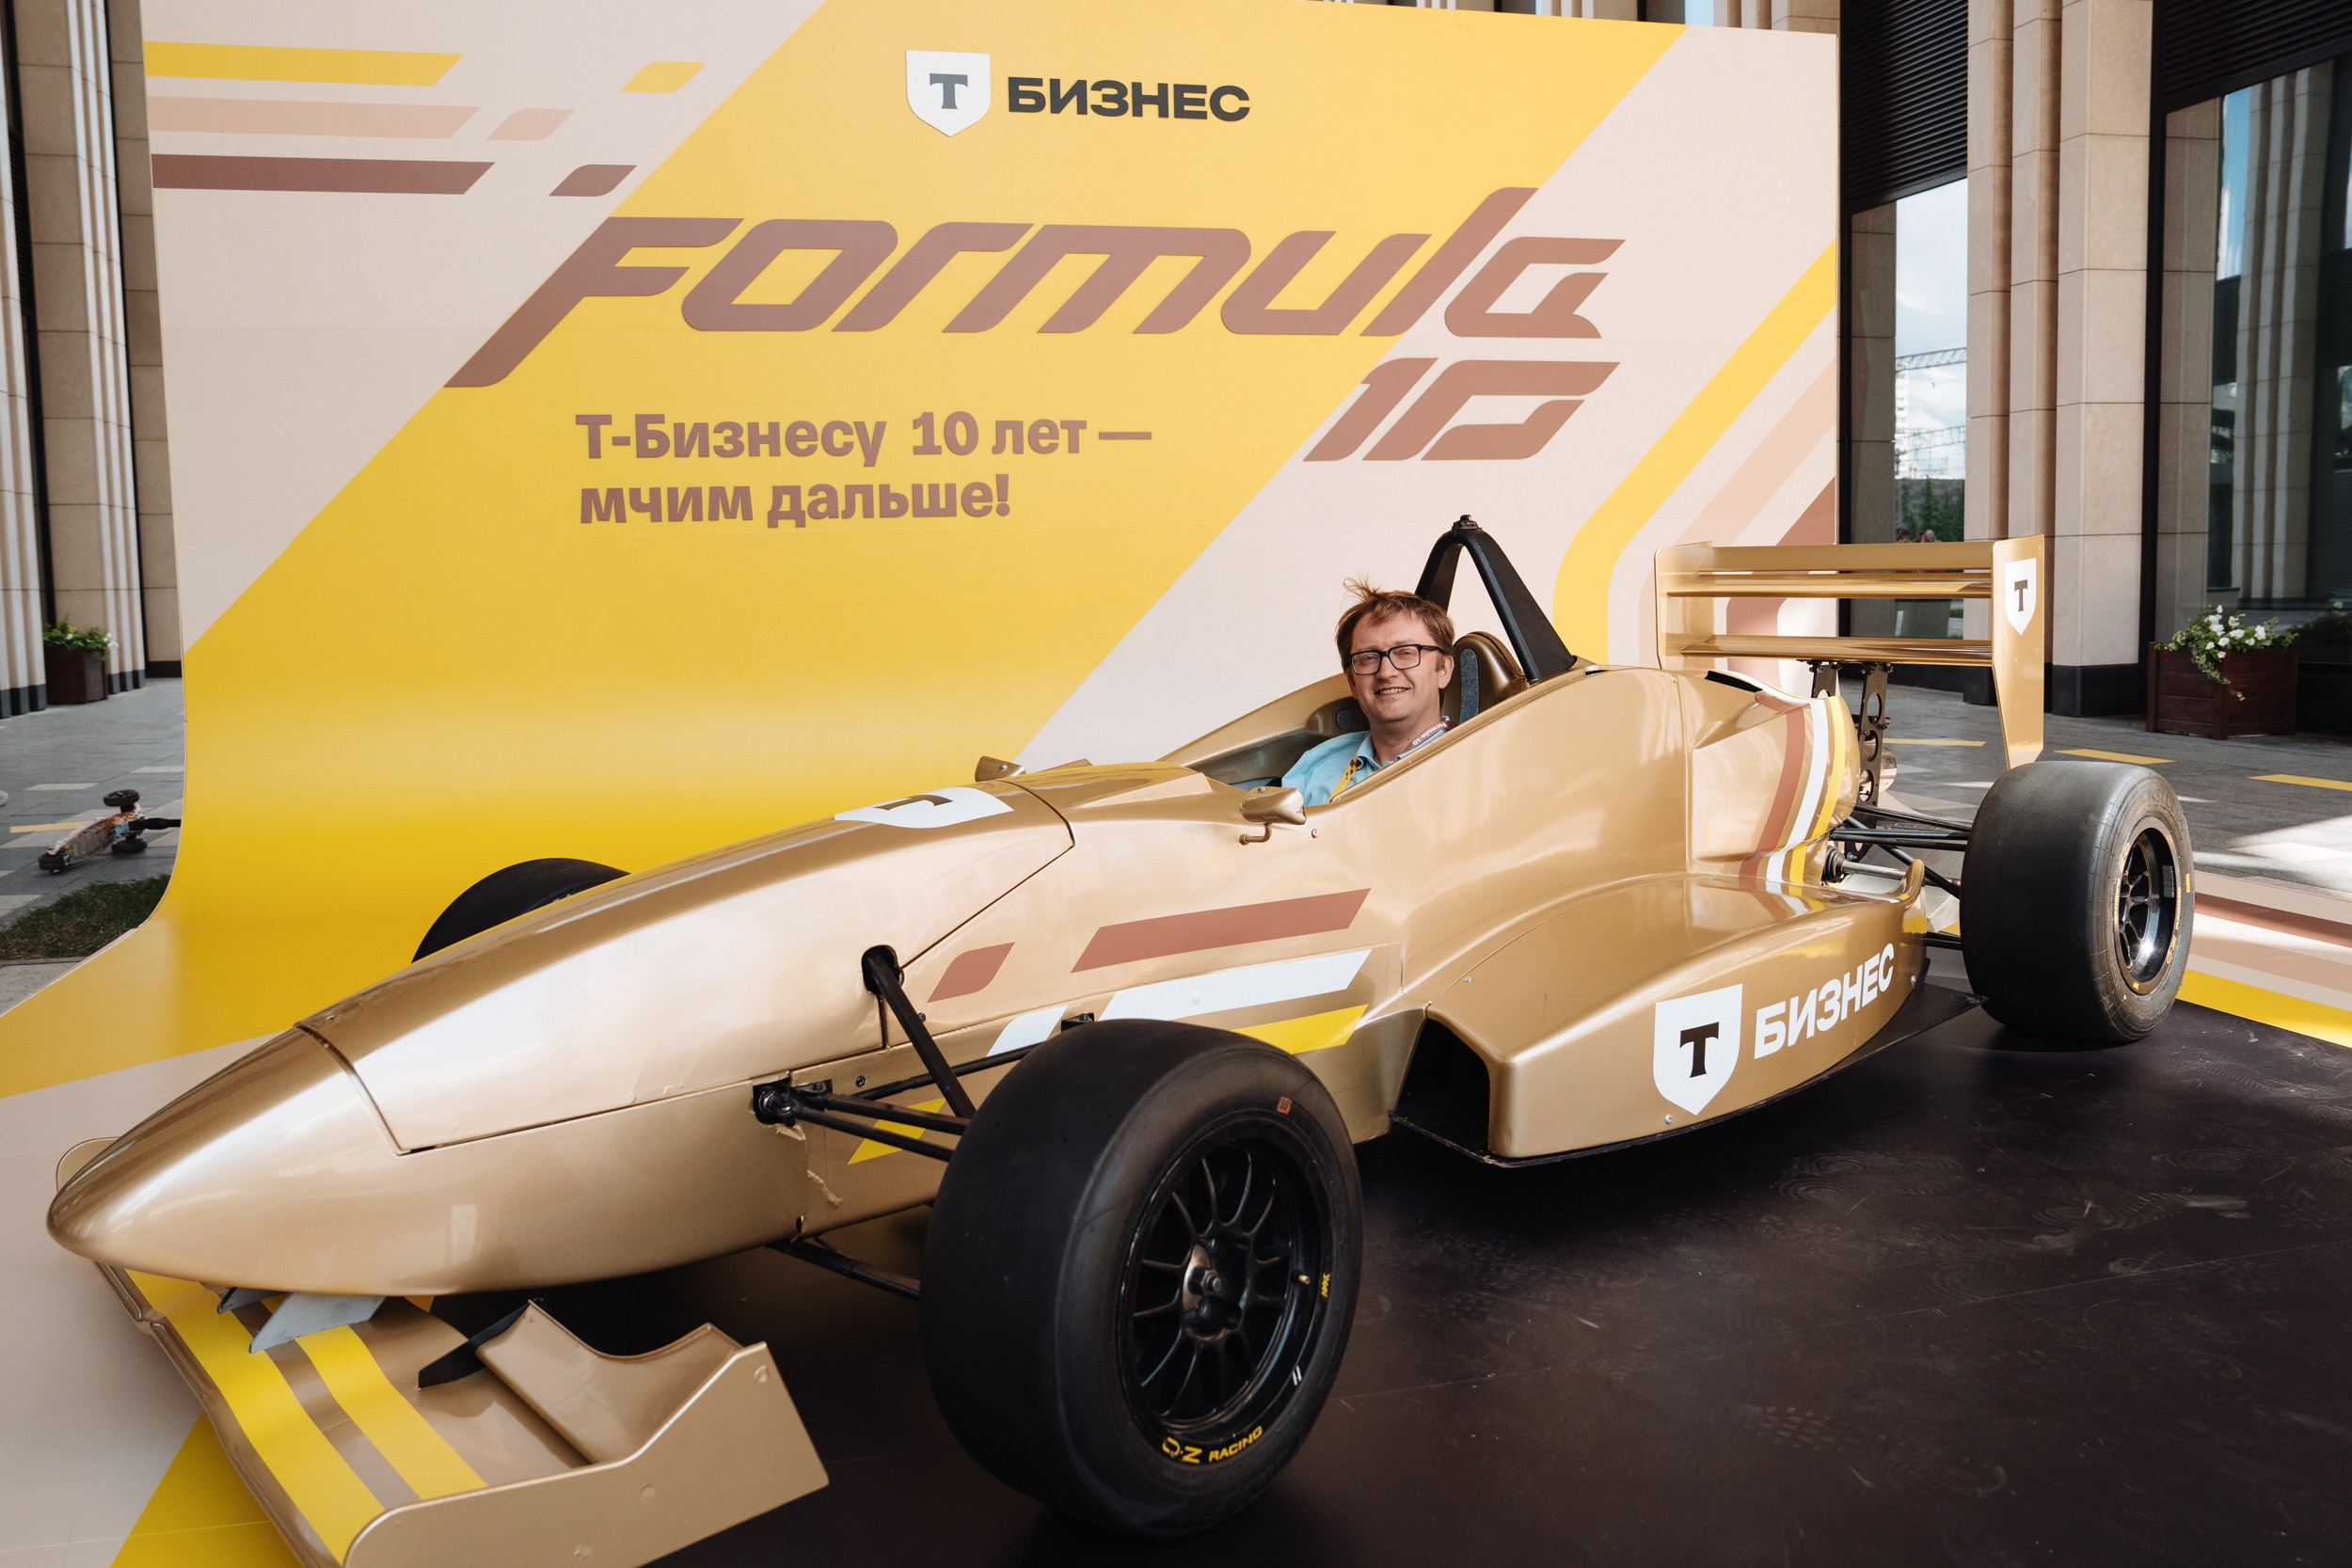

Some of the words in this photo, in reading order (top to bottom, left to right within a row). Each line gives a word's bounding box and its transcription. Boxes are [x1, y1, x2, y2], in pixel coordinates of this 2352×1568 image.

[1008, 76, 1251, 122] БИЗНЕС
[443, 186, 1627, 387] Formula
[575, 413, 888, 467] Т-Бизнесу
[912, 410, 980, 456] 10
[992, 418, 1088, 455] лет
[580, 484, 754, 524] мчим
[767, 473, 1011, 529] дальше!
[1754, 942, 1895, 1060] БИЗНЕС
[1208, 1425, 1263, 1464] RACING
